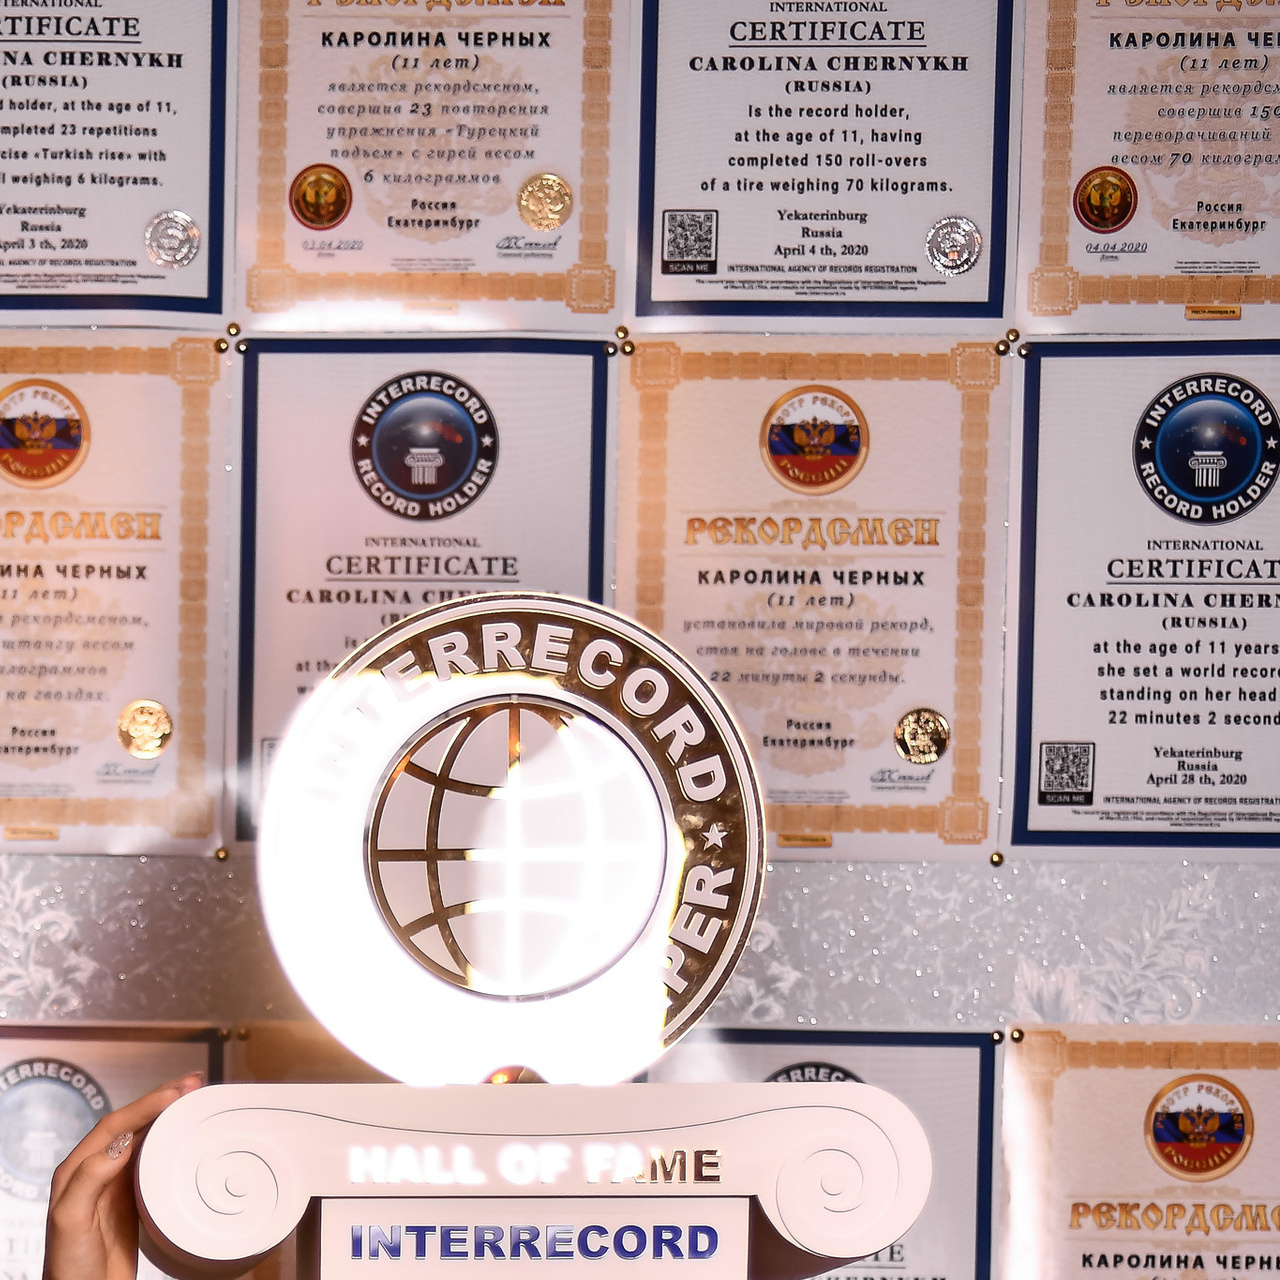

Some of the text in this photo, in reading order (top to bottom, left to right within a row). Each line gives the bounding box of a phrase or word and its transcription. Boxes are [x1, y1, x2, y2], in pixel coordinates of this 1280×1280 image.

[769, 0, 888, 13] INTERNATIONAL
[729, 21, 926, 41] CERTIFICATE
[43, 50, 183, 68] CHERNYKH
[688, 55, 969, 71] CAROLINA CHERNYKH
[700, 177, 953, 195] of a tire weighing 70 kilograms.
[777, 208, 868, 224] Yekaterinburg
[801, 226, 843, 239] Russia
[684, 515, 941, 551] РЕКОРДСМЕН
[1147, 539, 1264, 550] INTERNATIONAL
[698, 568, 925, 585] КАРОЛИНА ЧЕРНЫХ
[1161, 615, 1247, 631] (RUSSIA)
[349, 1142, 723, 1185] HALL OF FAME
[350, 1224, 719, 1261] INTERRECORD
[1081, 1253, 1205, 1269] КАРОЛИНА
